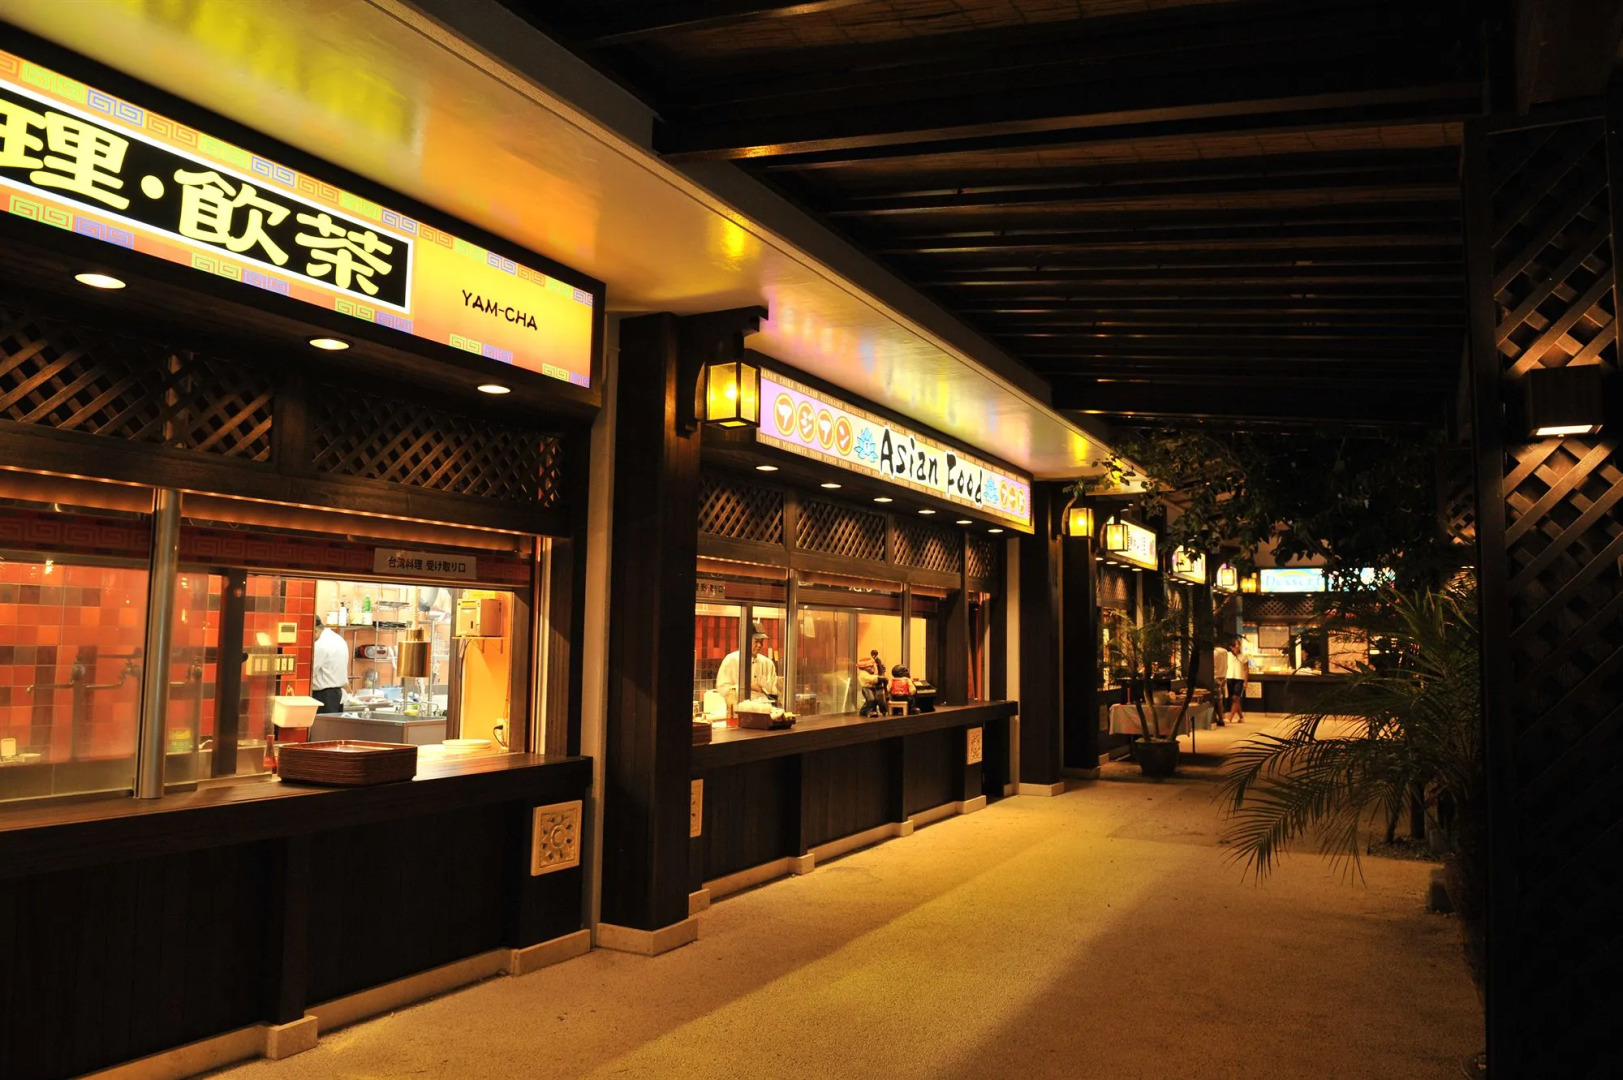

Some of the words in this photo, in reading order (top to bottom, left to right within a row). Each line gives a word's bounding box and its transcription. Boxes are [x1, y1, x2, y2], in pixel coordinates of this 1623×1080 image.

[462, 289, 538, 331] YAM-CHA
[880, 428, 939, 485] Asian
[946, 452, 984, 504] Food
